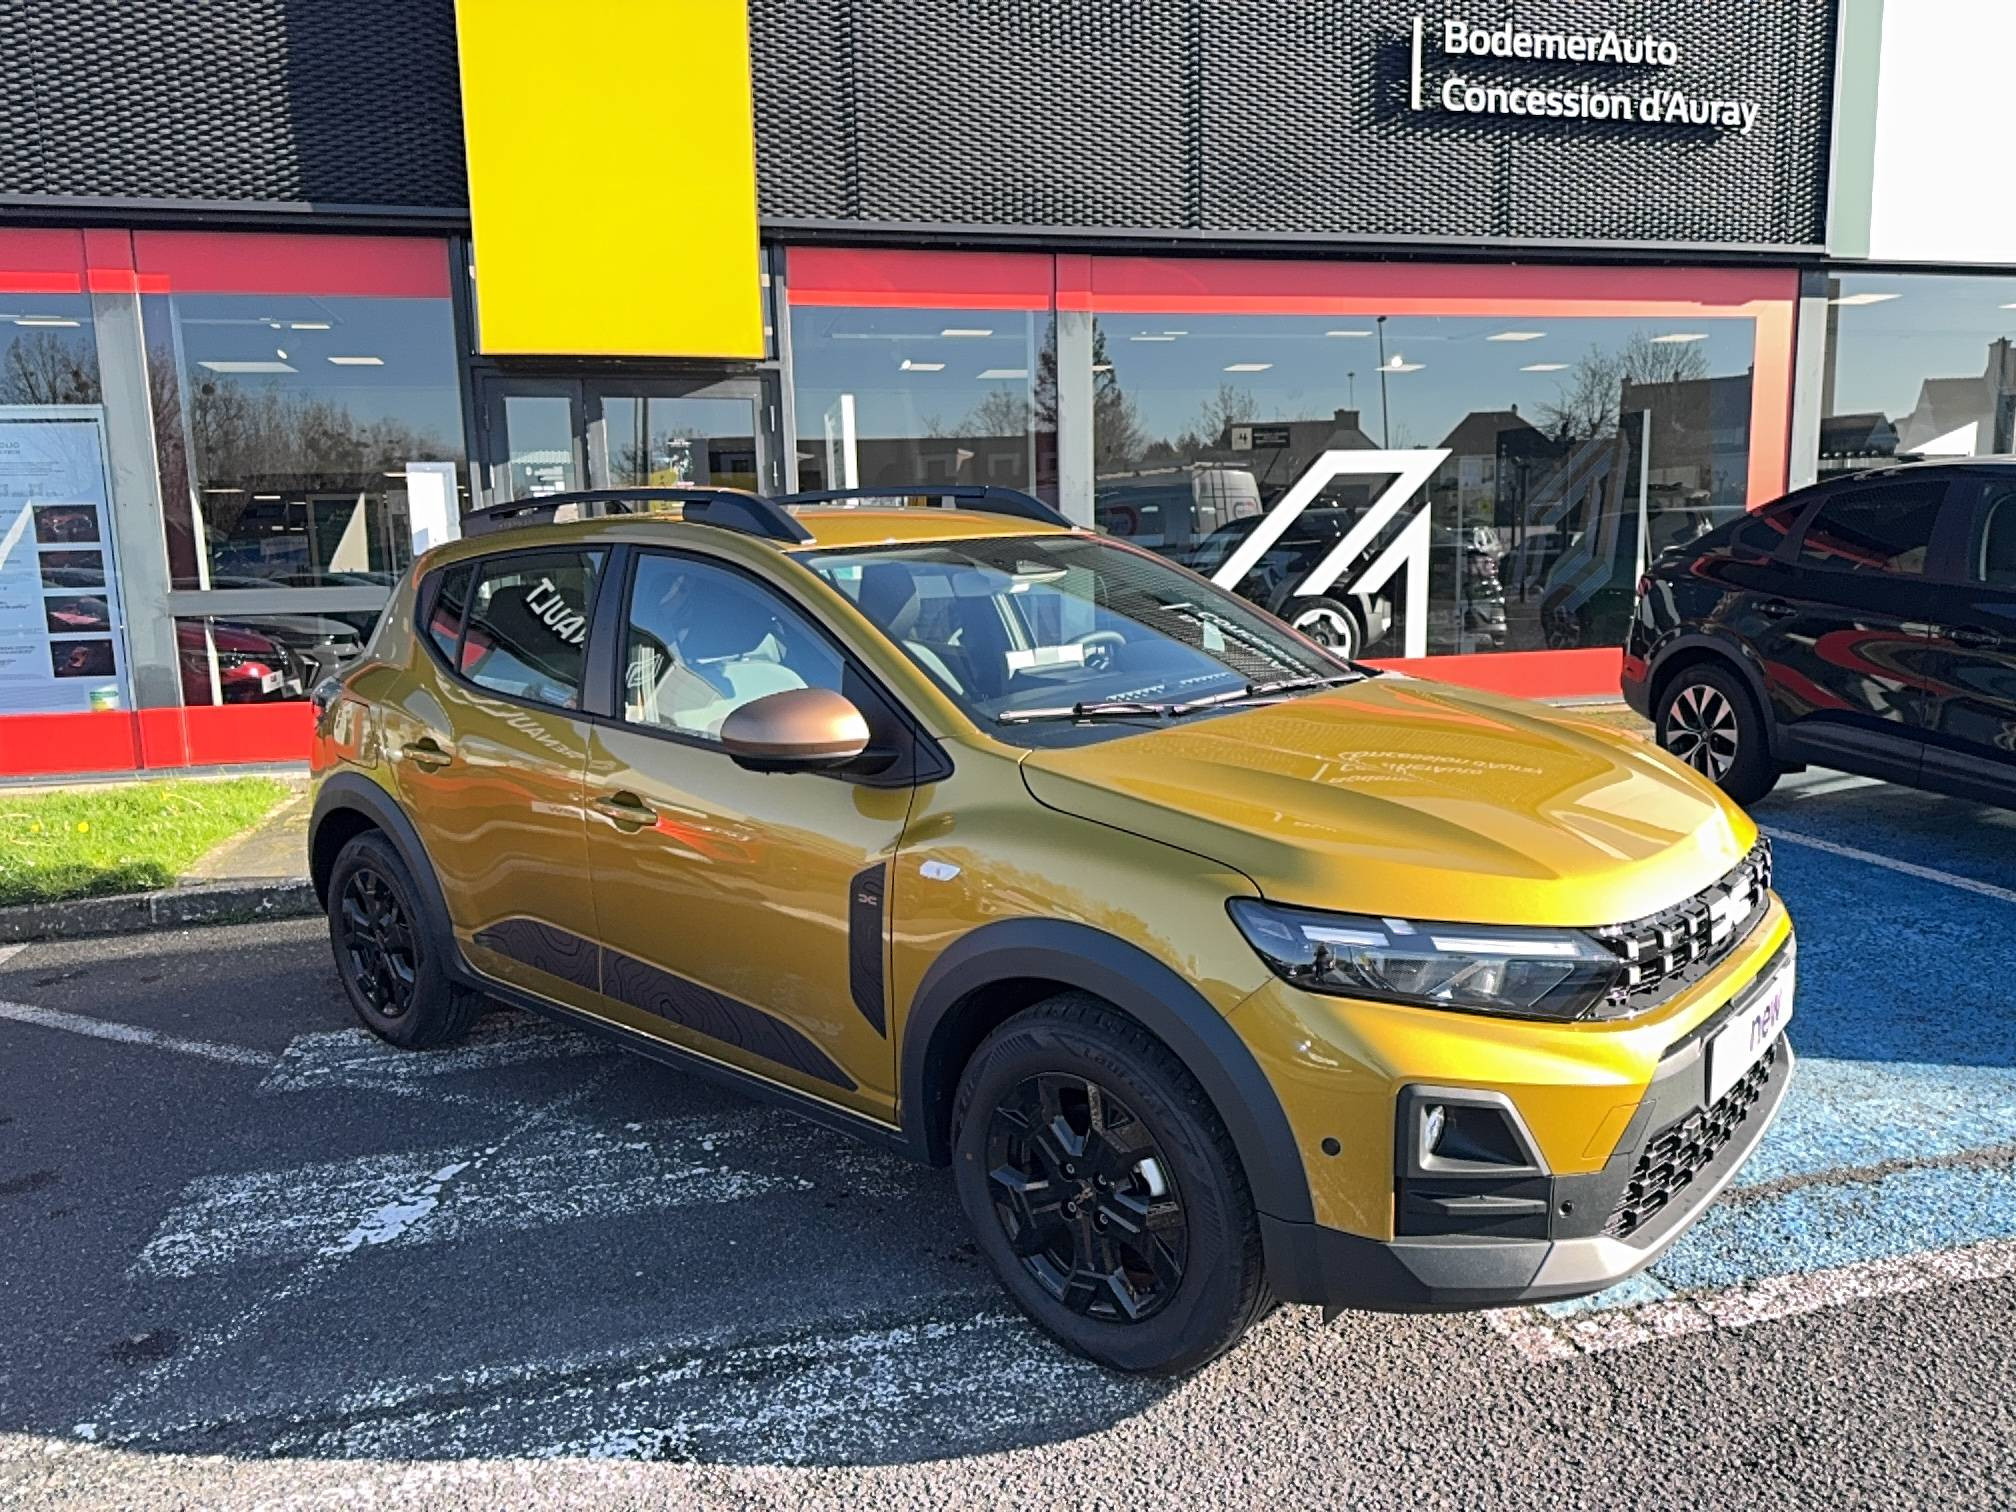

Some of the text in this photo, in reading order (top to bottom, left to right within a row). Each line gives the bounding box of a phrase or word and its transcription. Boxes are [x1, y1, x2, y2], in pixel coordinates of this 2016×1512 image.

[1443, 19, 1678, 66] BodemerAuto
[1441, 77, 1760, 135] Concession d'Auray
[1750, 988, 1783, 1053] new
